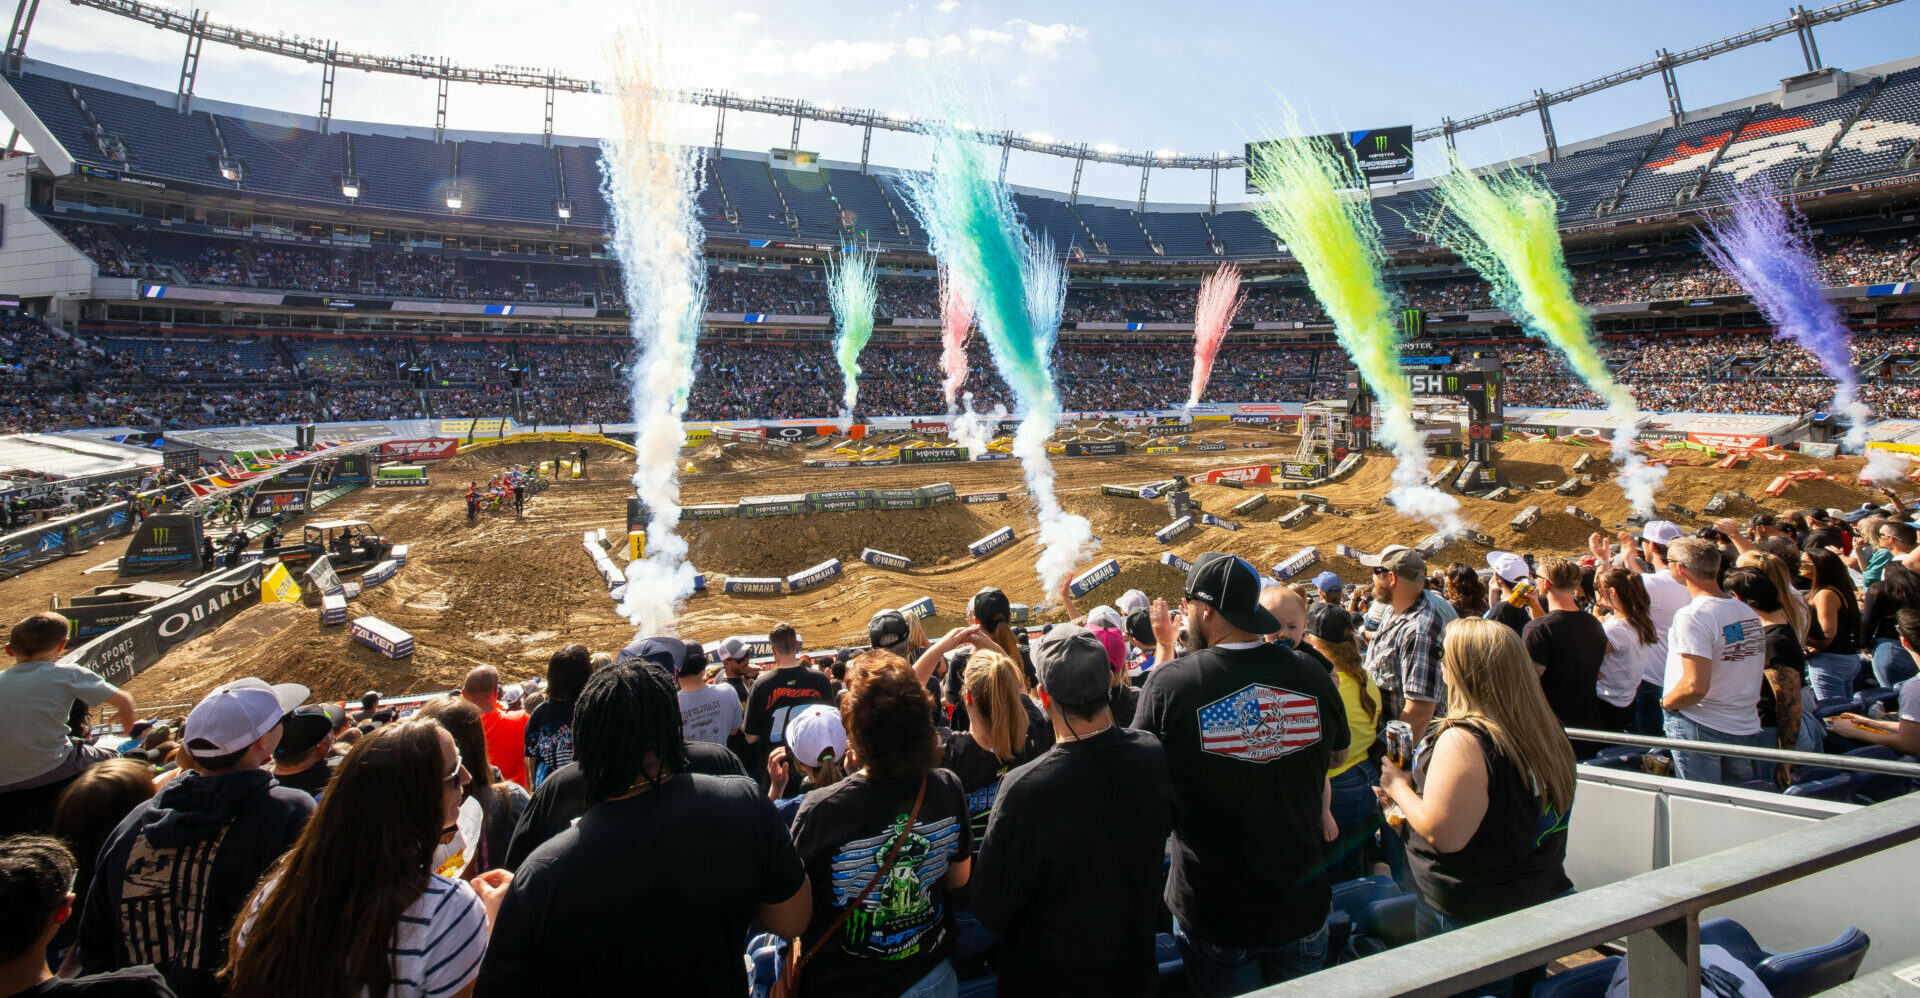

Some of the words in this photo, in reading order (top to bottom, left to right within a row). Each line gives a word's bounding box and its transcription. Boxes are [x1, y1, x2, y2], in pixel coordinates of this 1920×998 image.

[1655, 213, 1679, 221] TAYLOR
[1587, 223, 1616, 231] JACKSON
[1511, 426, 1546, 434] MONSTER
[916, 449, 956, 457] MONSTER
[55, 478, 89, 491] MOUNTAIN
[256, 506, 272, 514] 100
[1169, 521, 1190, 537] YAMAHA
[985, 532, 1010, 553] YAMAHA
[880, 555, 907, 569] YAMAHA
[1291, 551, 1316, 571] YAMAHA
[805, 565, 836, 585] YAMAHA
[1087, 564, 1114, 586] YAMAHA
[275, 575, 293, 600] SUZUKI
[742, 583, 775, 594] YAMAHA
[191, 575, 262, 622] OAKLEY
[95, 614, 136, 624] MONSTER
[352, 625, 395, 653] FALKEN
[101, 638, 134, 663] SPORTS
[765, 687, 822, 710] LAWRENCE
[1286, 715, 1316, 725] FLANNEL
[1245, 745, 1285, 758] AMERICAN
